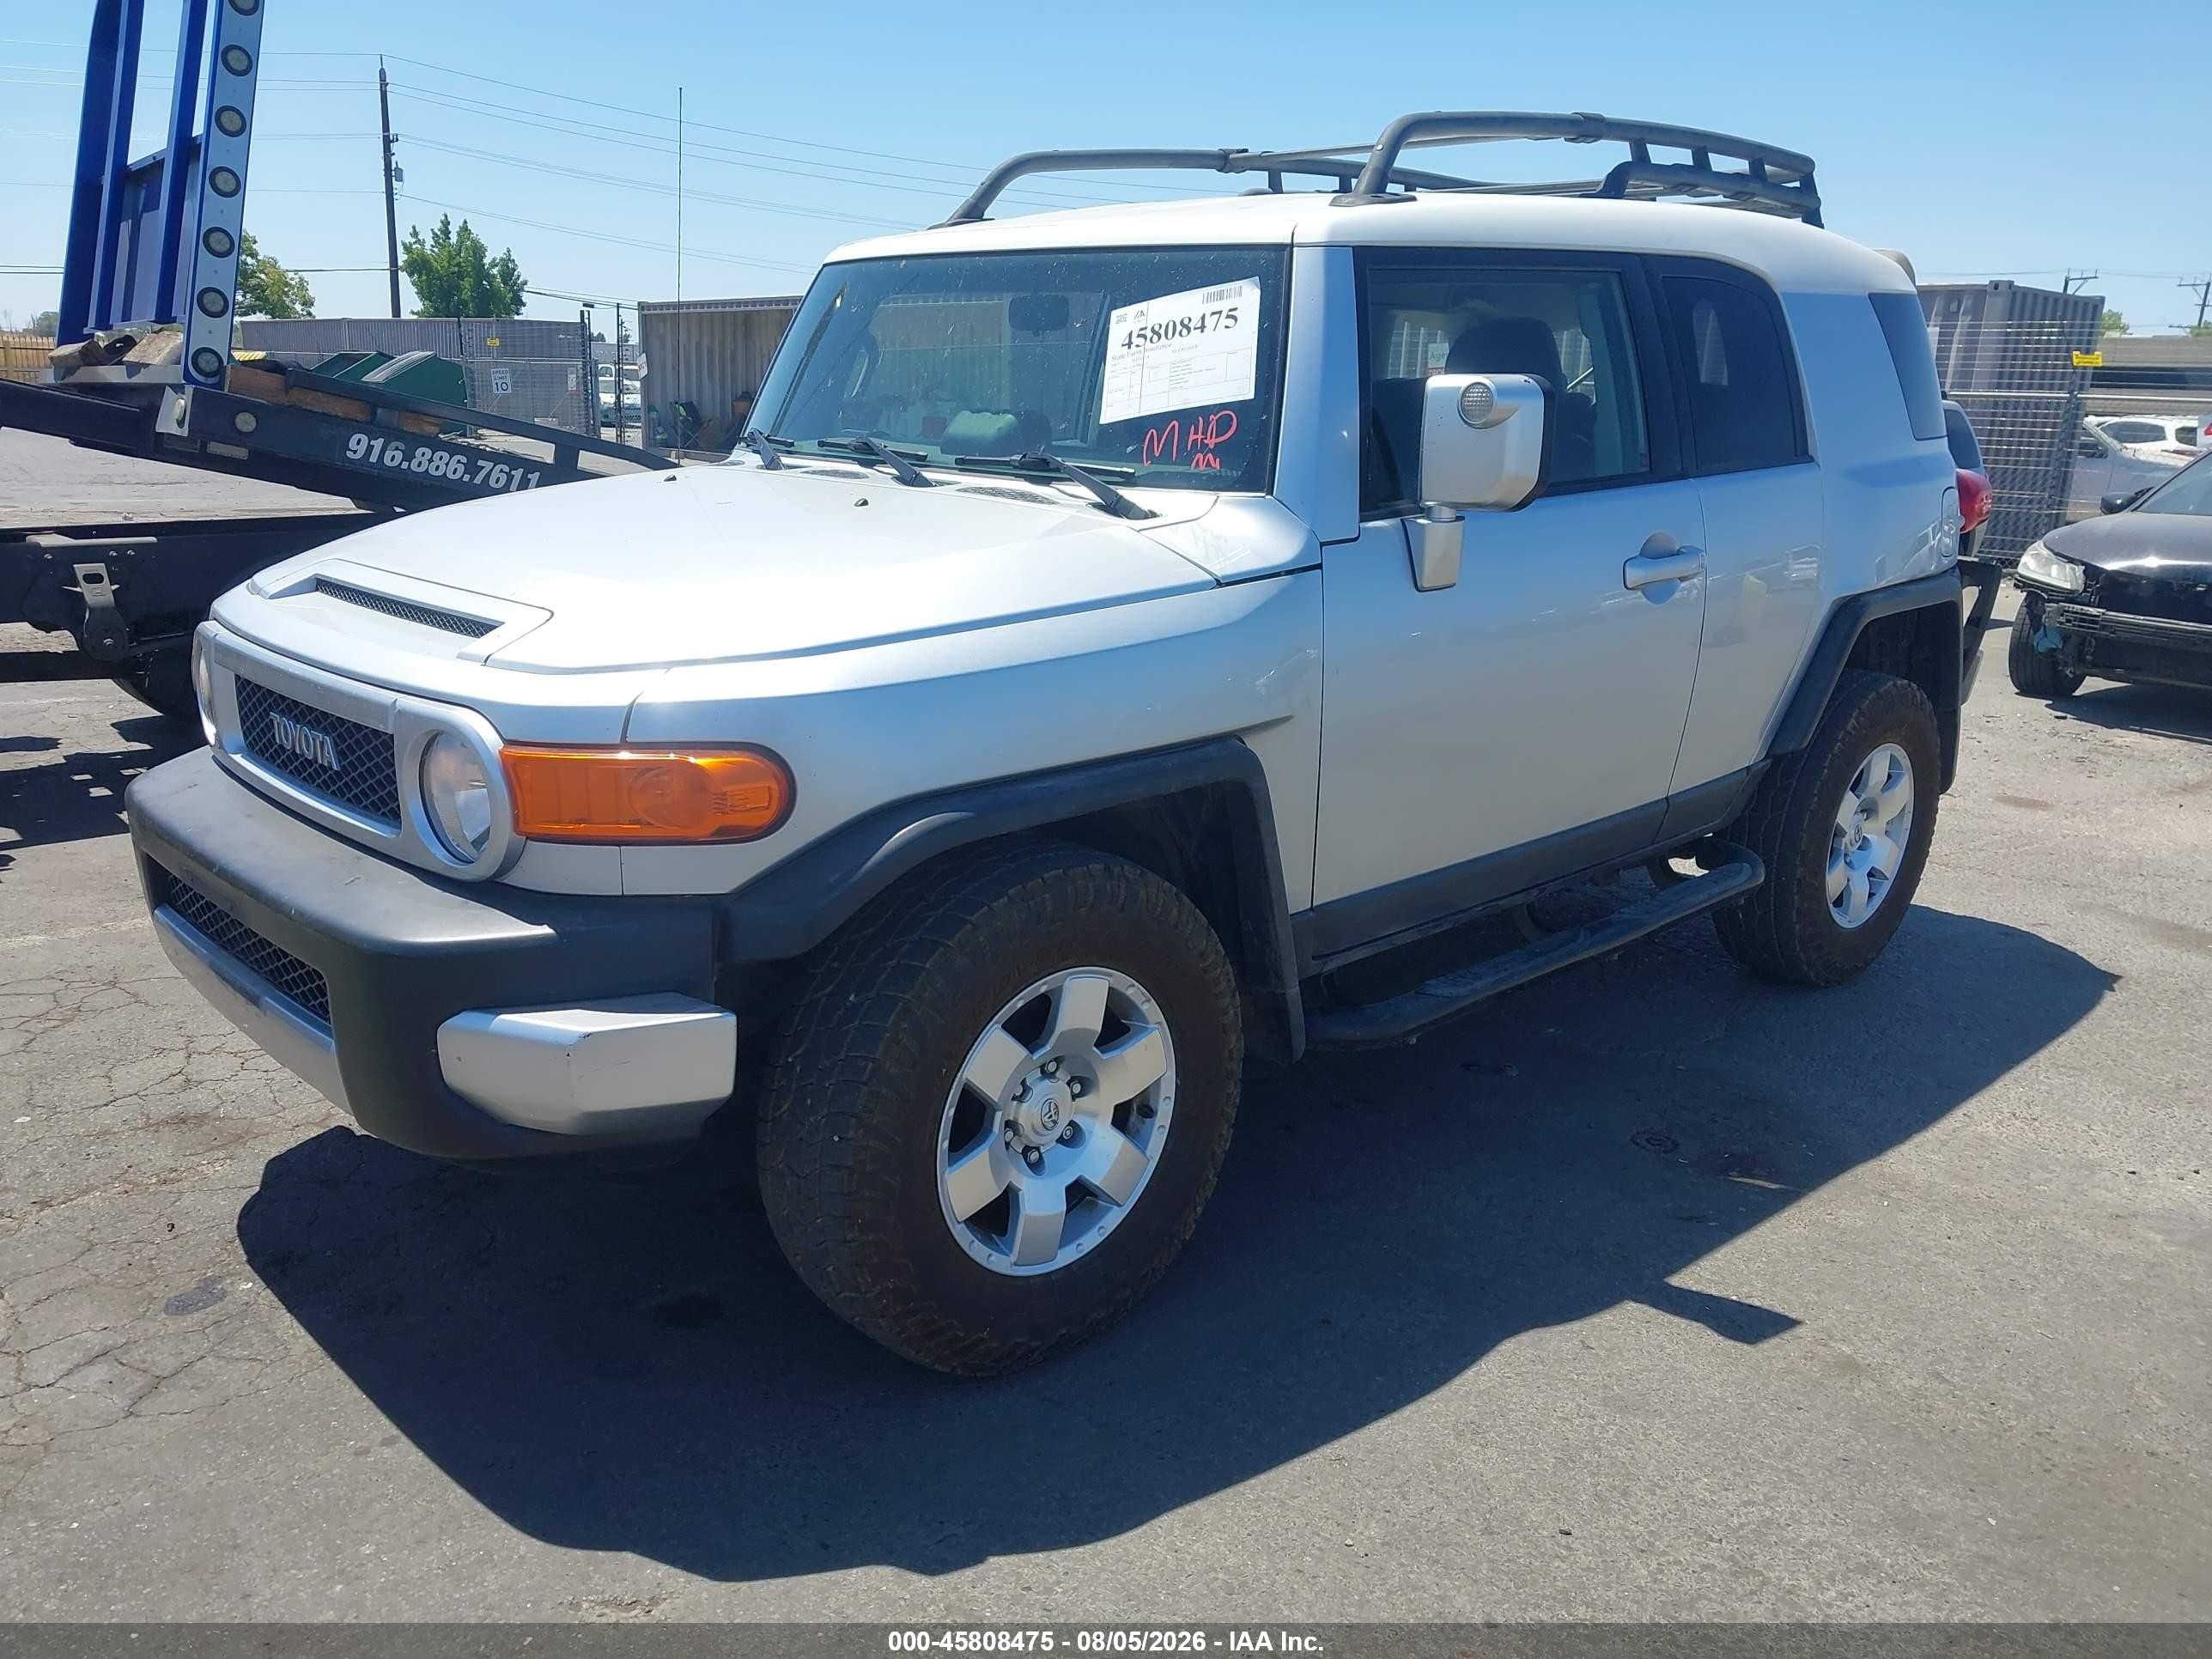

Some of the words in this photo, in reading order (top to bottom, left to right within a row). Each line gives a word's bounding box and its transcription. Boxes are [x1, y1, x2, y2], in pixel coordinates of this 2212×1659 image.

[1121, 307, 1239, 350] 45808475
[495, 381, 509, 392] 10
[345, 433, 541, 492] 916.886.7611
[269, 711, 341, 771] TOYOTA
